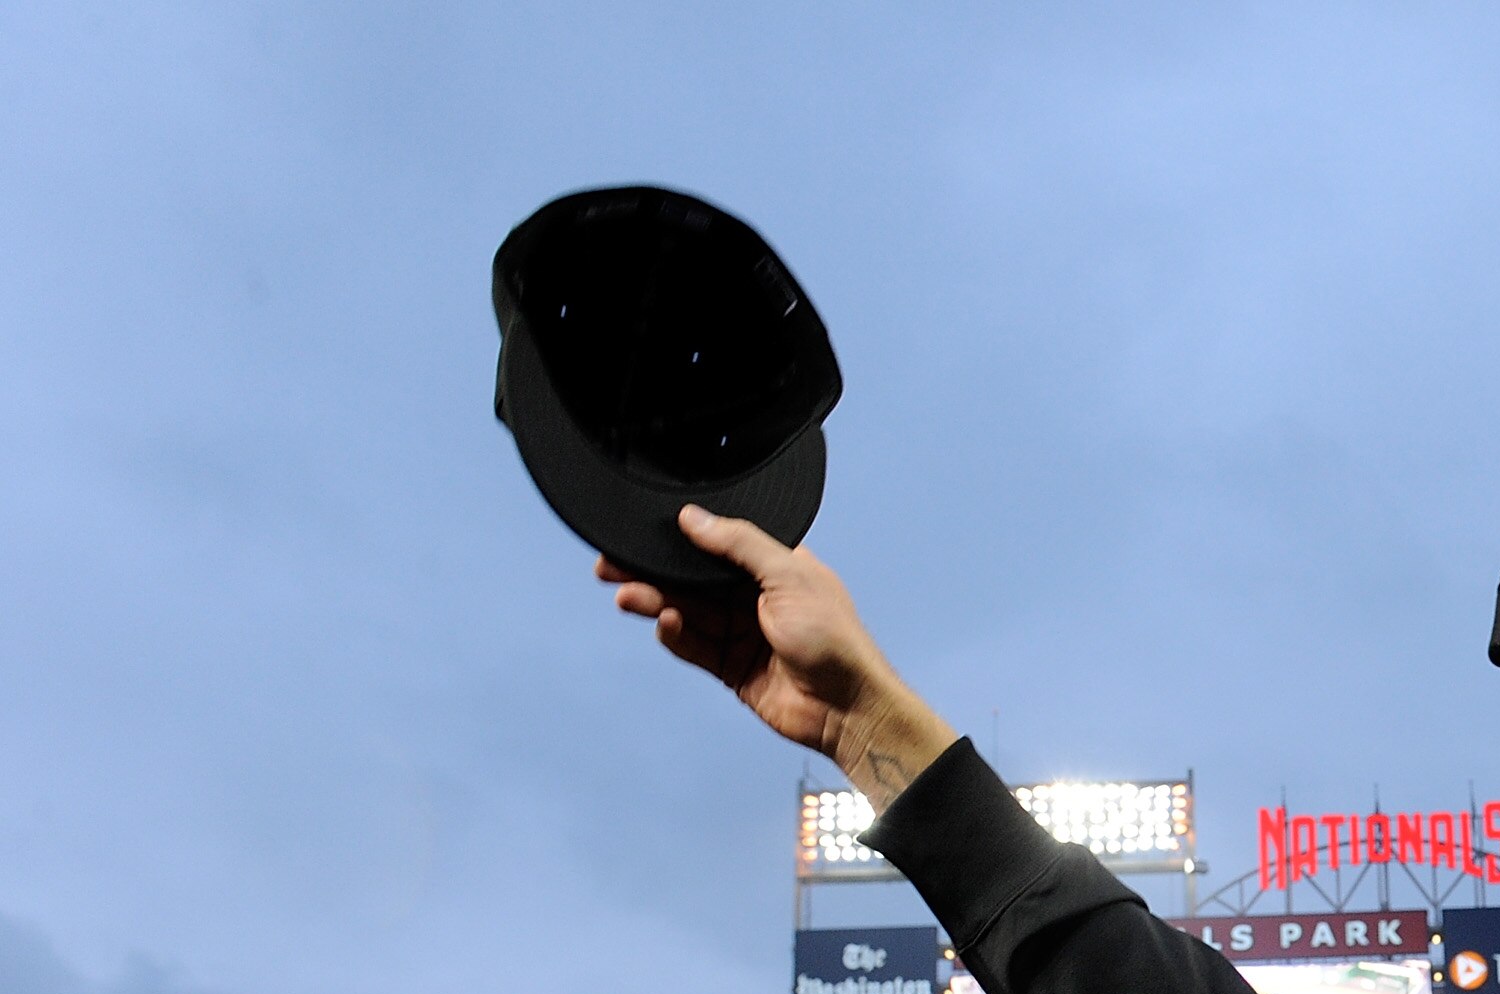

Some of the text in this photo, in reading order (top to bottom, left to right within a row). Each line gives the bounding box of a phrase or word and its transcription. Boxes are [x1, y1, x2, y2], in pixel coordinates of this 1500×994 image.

[1180, 919, 1403, 951] LS PARK
[842, 943, 888, 972] The
